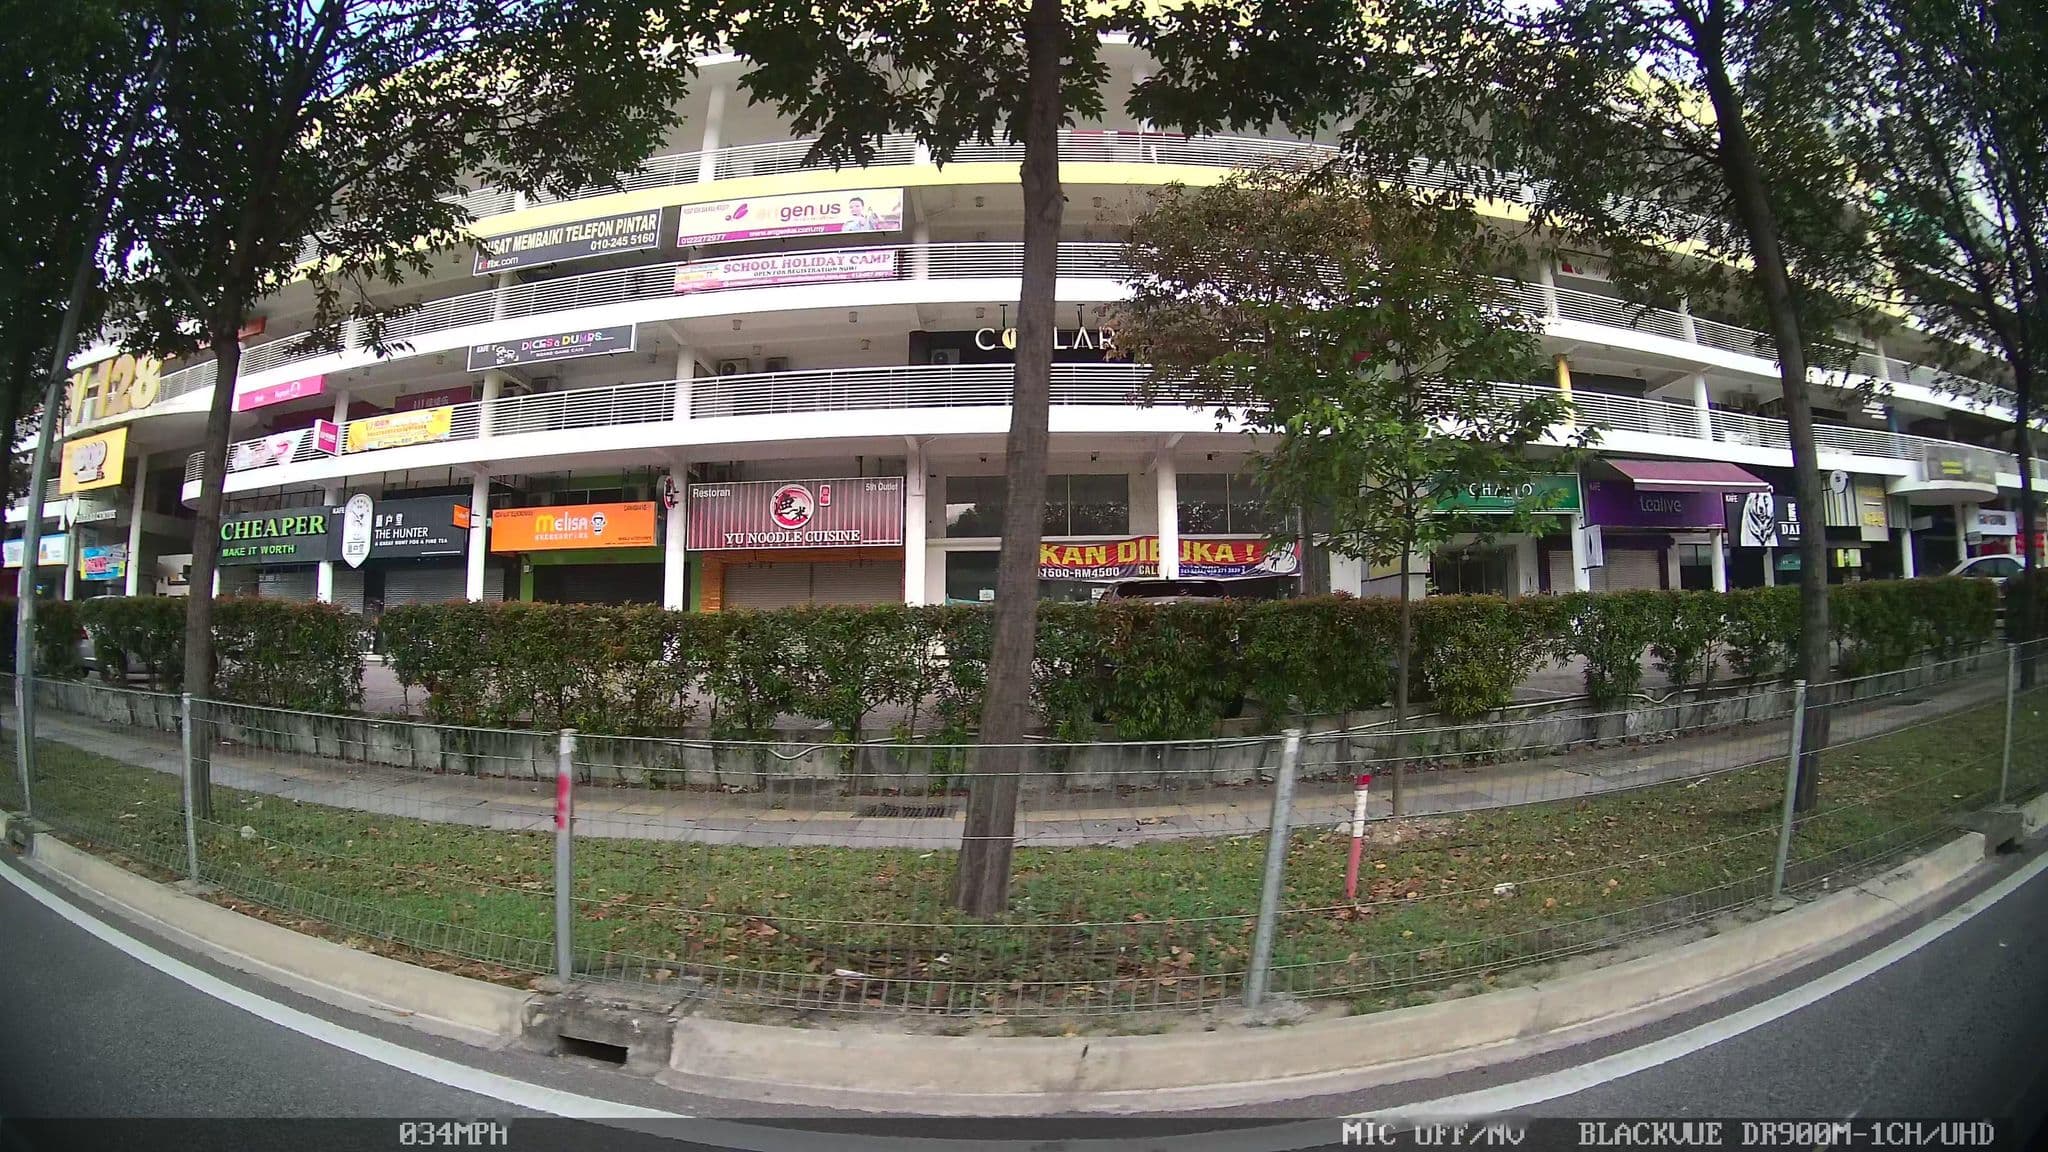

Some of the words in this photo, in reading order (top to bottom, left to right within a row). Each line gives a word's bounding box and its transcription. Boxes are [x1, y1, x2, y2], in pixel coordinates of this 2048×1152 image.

[512, 228, 564, 252] MEMBAIKI
[565, 219, 614, 243] TELEFON
[615, 213, 657, 235] PINTAR
[590, 236, 628, 251] 010-245
[630, 232, 655, 245] 5160
[723, 260, 778, 274] SCHOOL
[781, 255, 845, 269] HOLIDAY
[849, 253, 891, 266] CAMP
[787, 267, 837, 275] REGISTRATION
[561, 331, 603, 346] DUMPS
[692, 487, 731, 498] Restoran
[865, 482, 877, 491] 5th
[878, 482, 898, 491] Outlet
[220, 515, 326, 541] CHEAPER
[375, 528, 391, 539] THE
[392, 526, 428, 539] HUNTER
[725, 532, 745, 545] YU
[747, 531, 803, 544] NOODLE
[805, 529, 861, 543] CUISINE
[222, 547, 246, 557] MAKE
[248, 546, 257, 555] IT
[260, 545, 295, 554] WORTH
